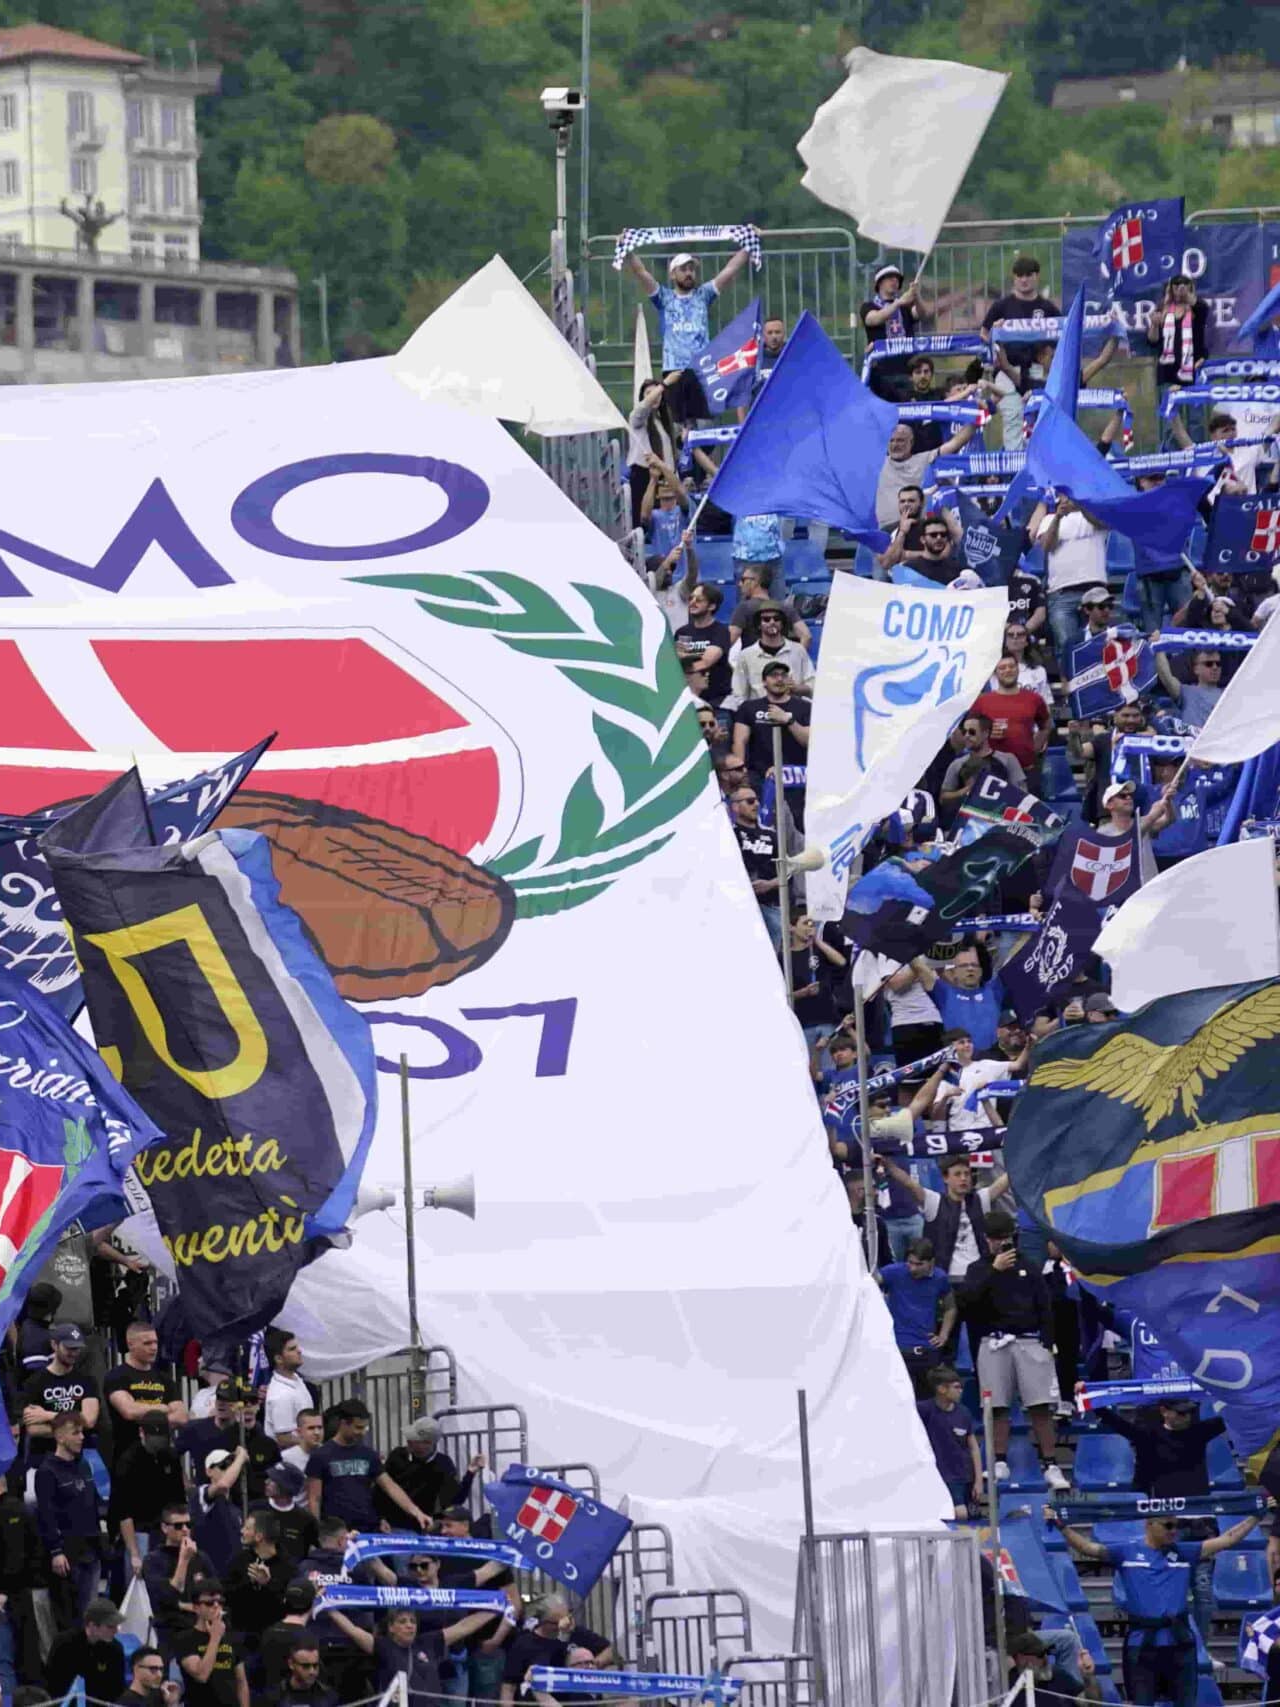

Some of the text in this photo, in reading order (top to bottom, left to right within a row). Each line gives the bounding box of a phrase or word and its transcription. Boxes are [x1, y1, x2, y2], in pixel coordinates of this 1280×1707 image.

[1002, 317, 1059, 332] CALCIO
[1241, 500, 1280, 514] CAL
[1219, 548, 1260, 563] CO
[883, 599, 976, 642] COMO
[1085, 860, 1126, 873] COMO
[365, 996, 577, 1083] 07
[135, 1128, 288, 1187] ledetta
[163, 1194, 308, 1267] ventù
[43, 1384, 85, 1400] COMO
[1136, 1496, 1187, 1513] COMO
